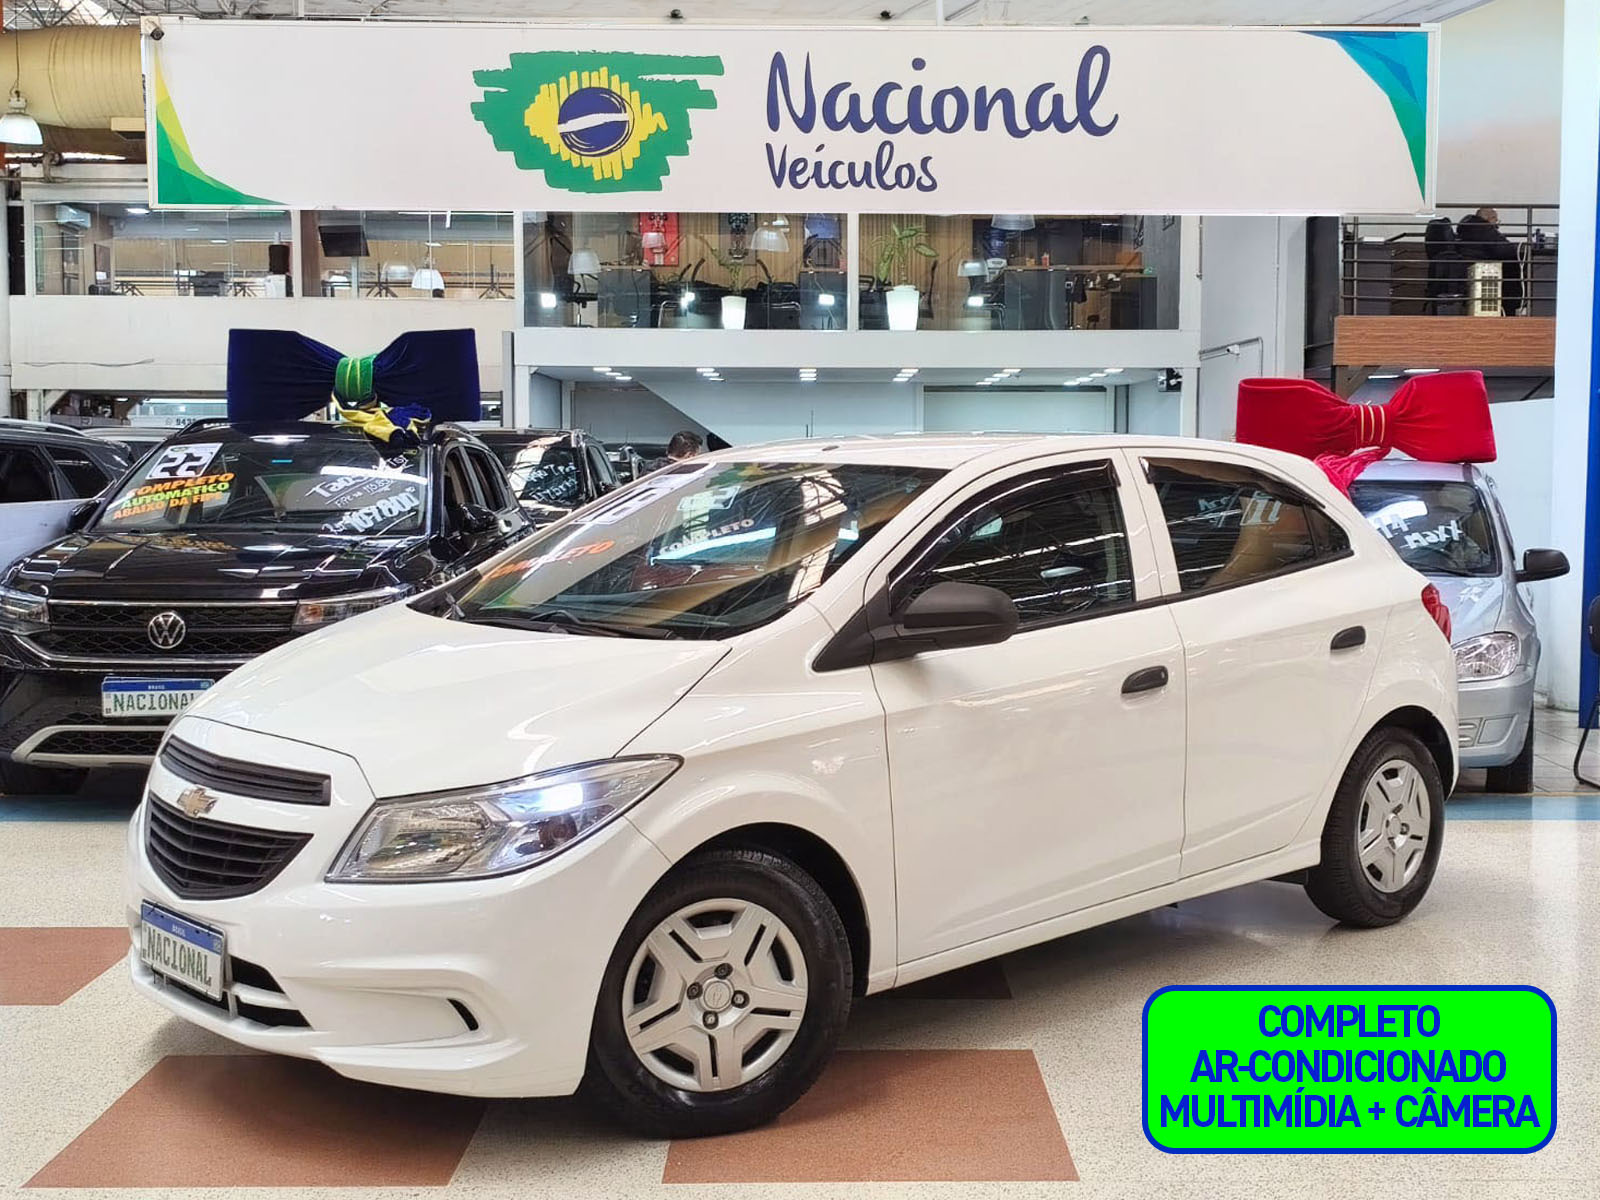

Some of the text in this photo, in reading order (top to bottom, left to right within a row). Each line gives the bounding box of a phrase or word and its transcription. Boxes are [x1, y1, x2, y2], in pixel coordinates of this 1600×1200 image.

[767, 45, 1119, 138] Nacional
[766, 140, 938, 192] Veículos
[150, 450, 214, 478] 22
[126, 472, 236, 498] COMPLETO
[169, 497, 190, 508] DA
[113, 693, 195, 712] NACIONA
[147, 927, 212, 987] NACIONAL
